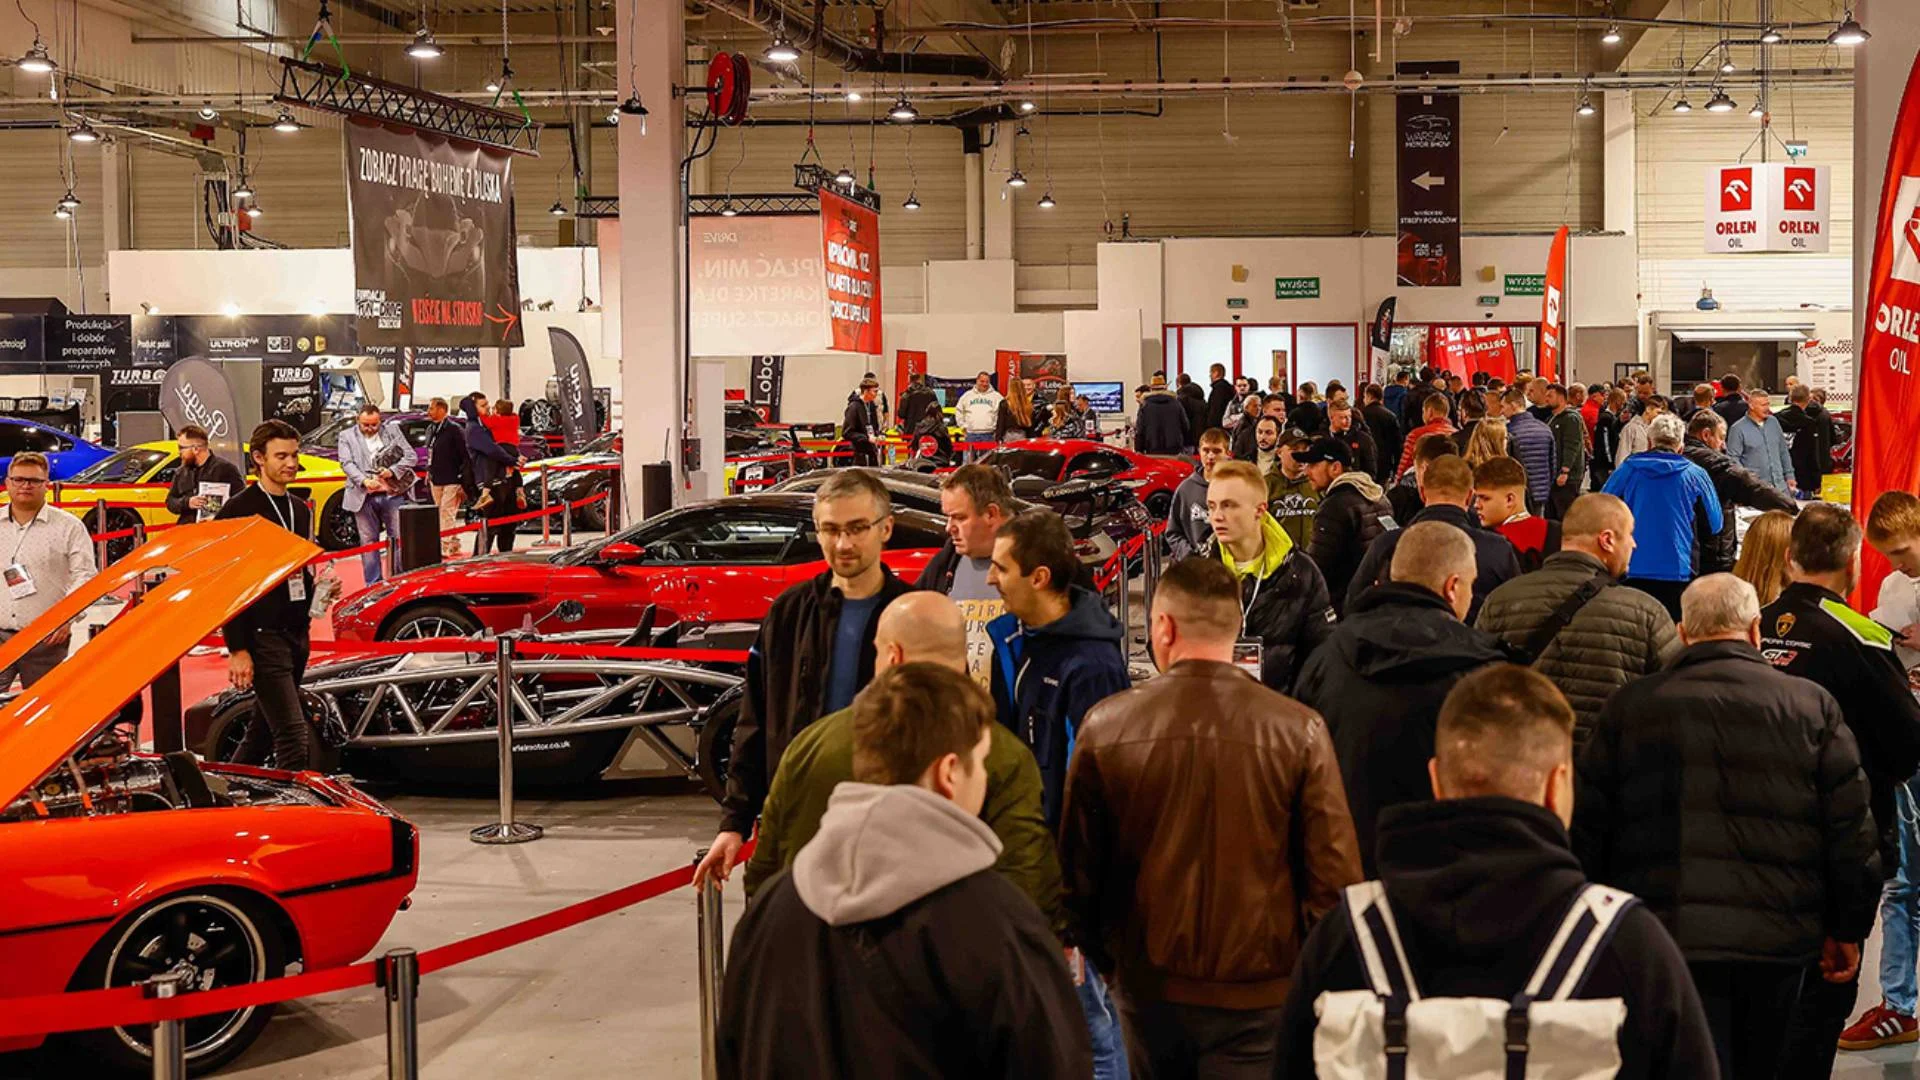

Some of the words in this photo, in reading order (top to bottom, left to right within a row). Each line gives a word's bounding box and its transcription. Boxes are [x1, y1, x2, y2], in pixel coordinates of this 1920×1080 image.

[359, 146, 397, 186] ZOBACZ
[466, 167, 474, 198] Z
[1715, 221, 1757, 235] ORLEN
[1779, 220, 1820, 234] ORLEN
[1728, 238, 1743, 248] OIL
[1791, 237, 1807, 248] OIL
[65, 319, 113, 331] Produkcja
[1875, 303, 1920, 344] ORLE
[77, 332, 105, 342] dobór
[62, 346, 116, 357] preparatów
[1889, 348, 1911, 375] OIL
[1275, 508, 1318, 517] Blaser
